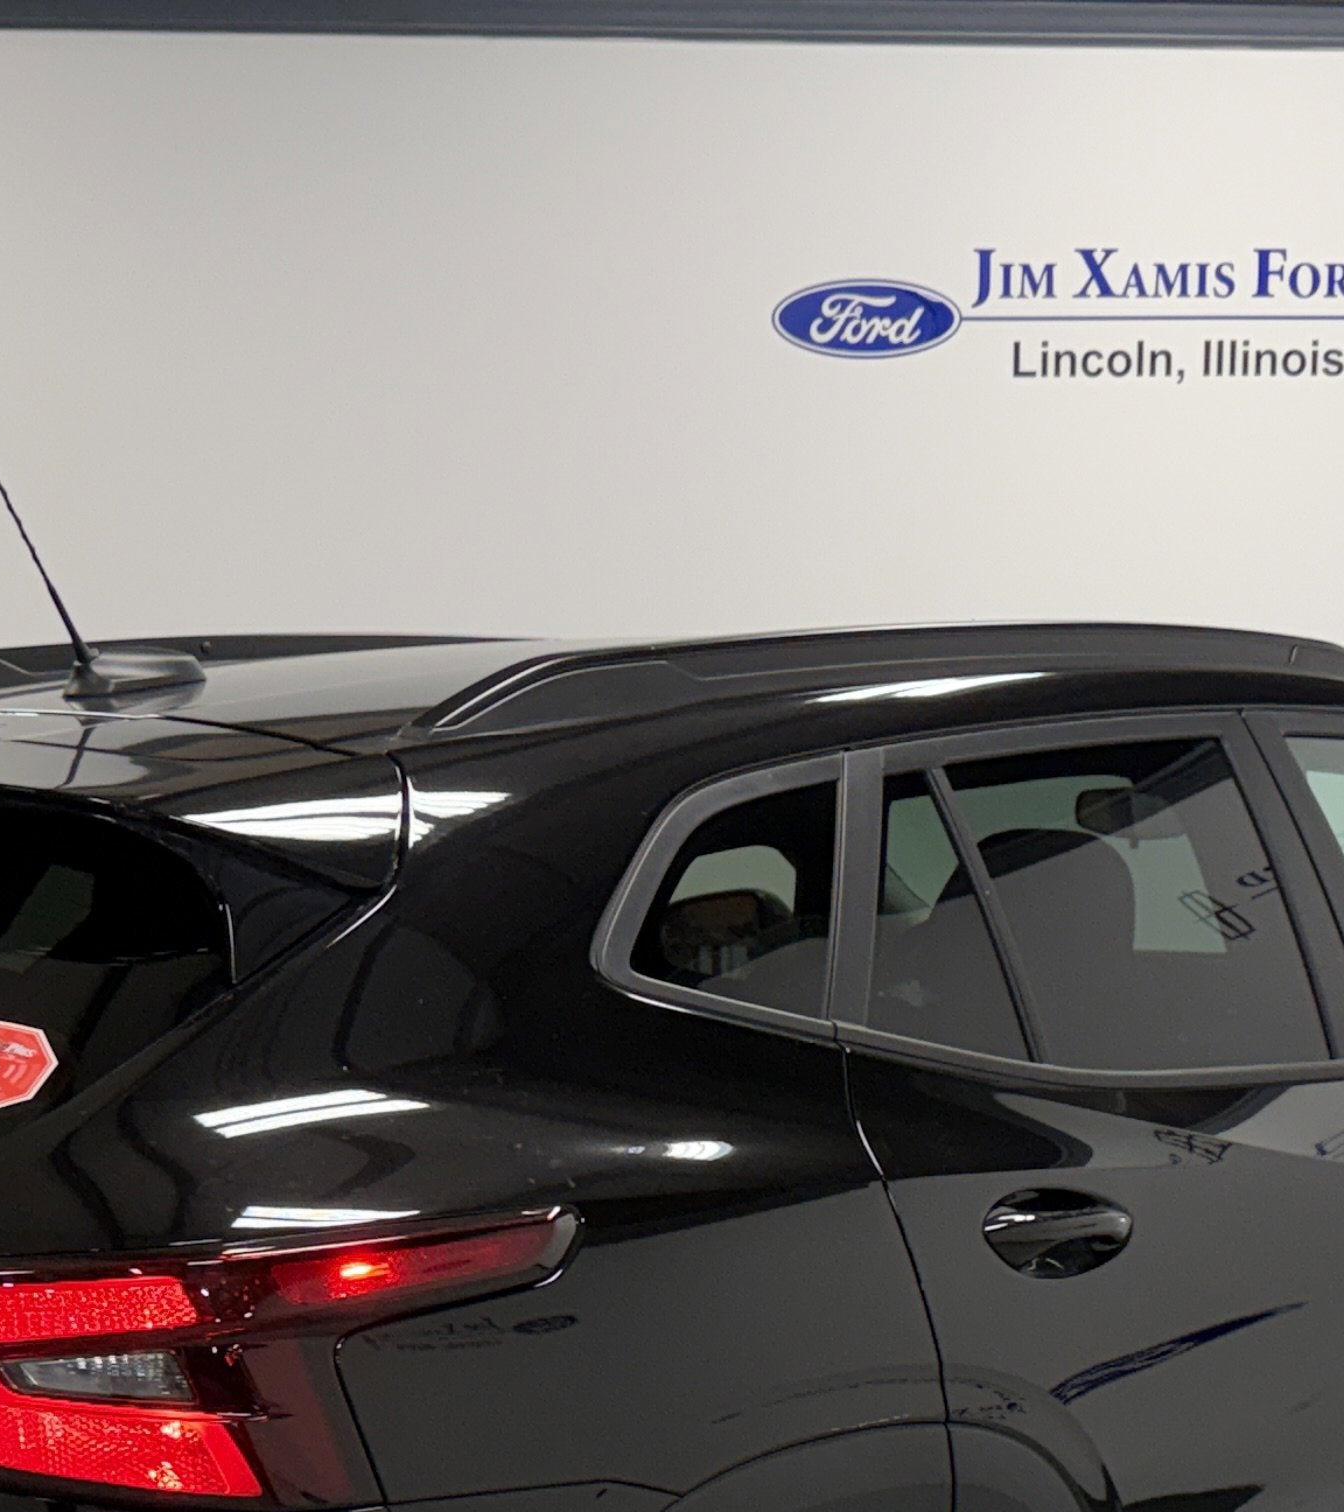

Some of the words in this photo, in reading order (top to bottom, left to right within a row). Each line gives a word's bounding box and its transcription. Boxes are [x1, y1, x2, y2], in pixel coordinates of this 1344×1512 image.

[971, 248, 1057, 308] JIM
[1074, 248, 1236, 299] XAMIS
[809, 292, 921, 346] Ford
[1011, 340, 1186, 384] Lincoln,
